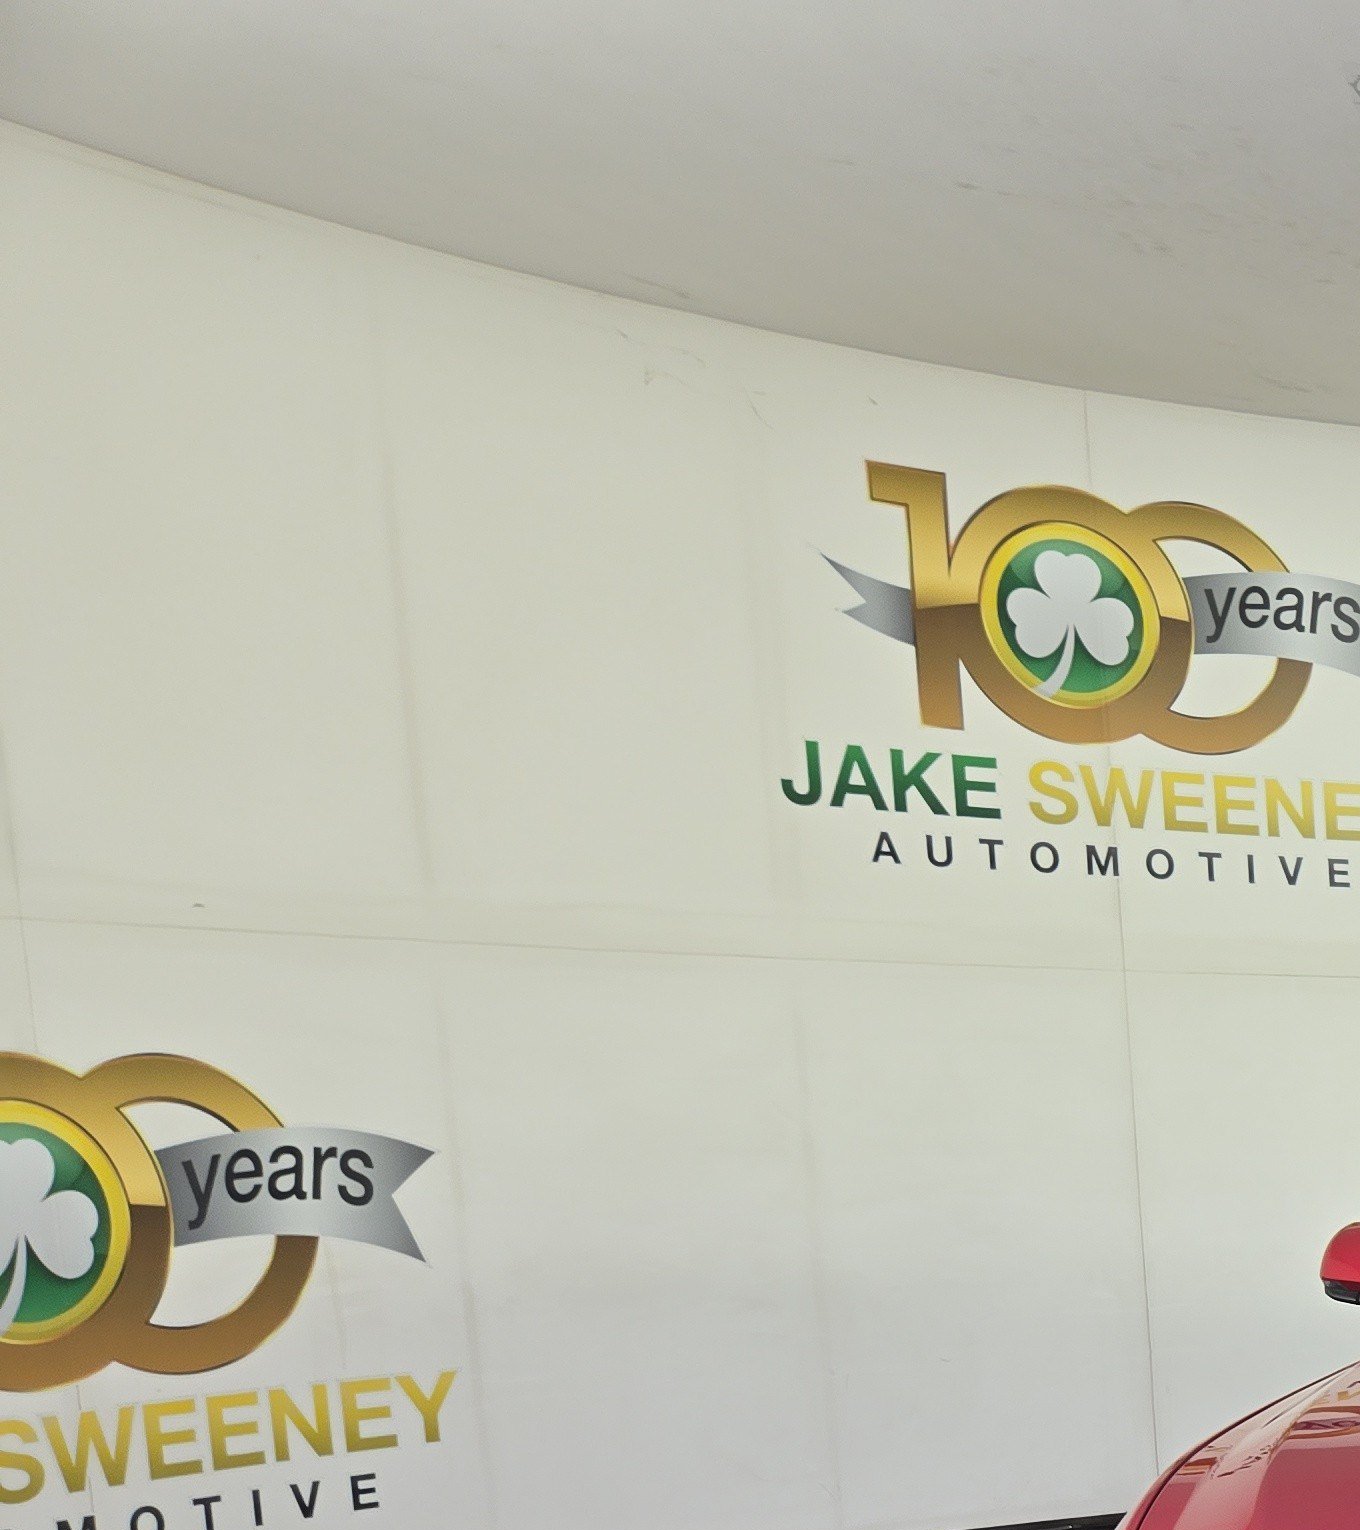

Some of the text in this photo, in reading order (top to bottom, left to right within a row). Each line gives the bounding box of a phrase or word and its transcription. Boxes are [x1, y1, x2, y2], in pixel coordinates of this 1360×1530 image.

[865, 459, 1312, 755] 100
[780, 739, 1002, 819] JAKE
[872, 831, 1352, 888] AUTOMOTIVE
[182, 1144, 375, 1230] years
[0, 1370, 457, 1506] SWEENEY
